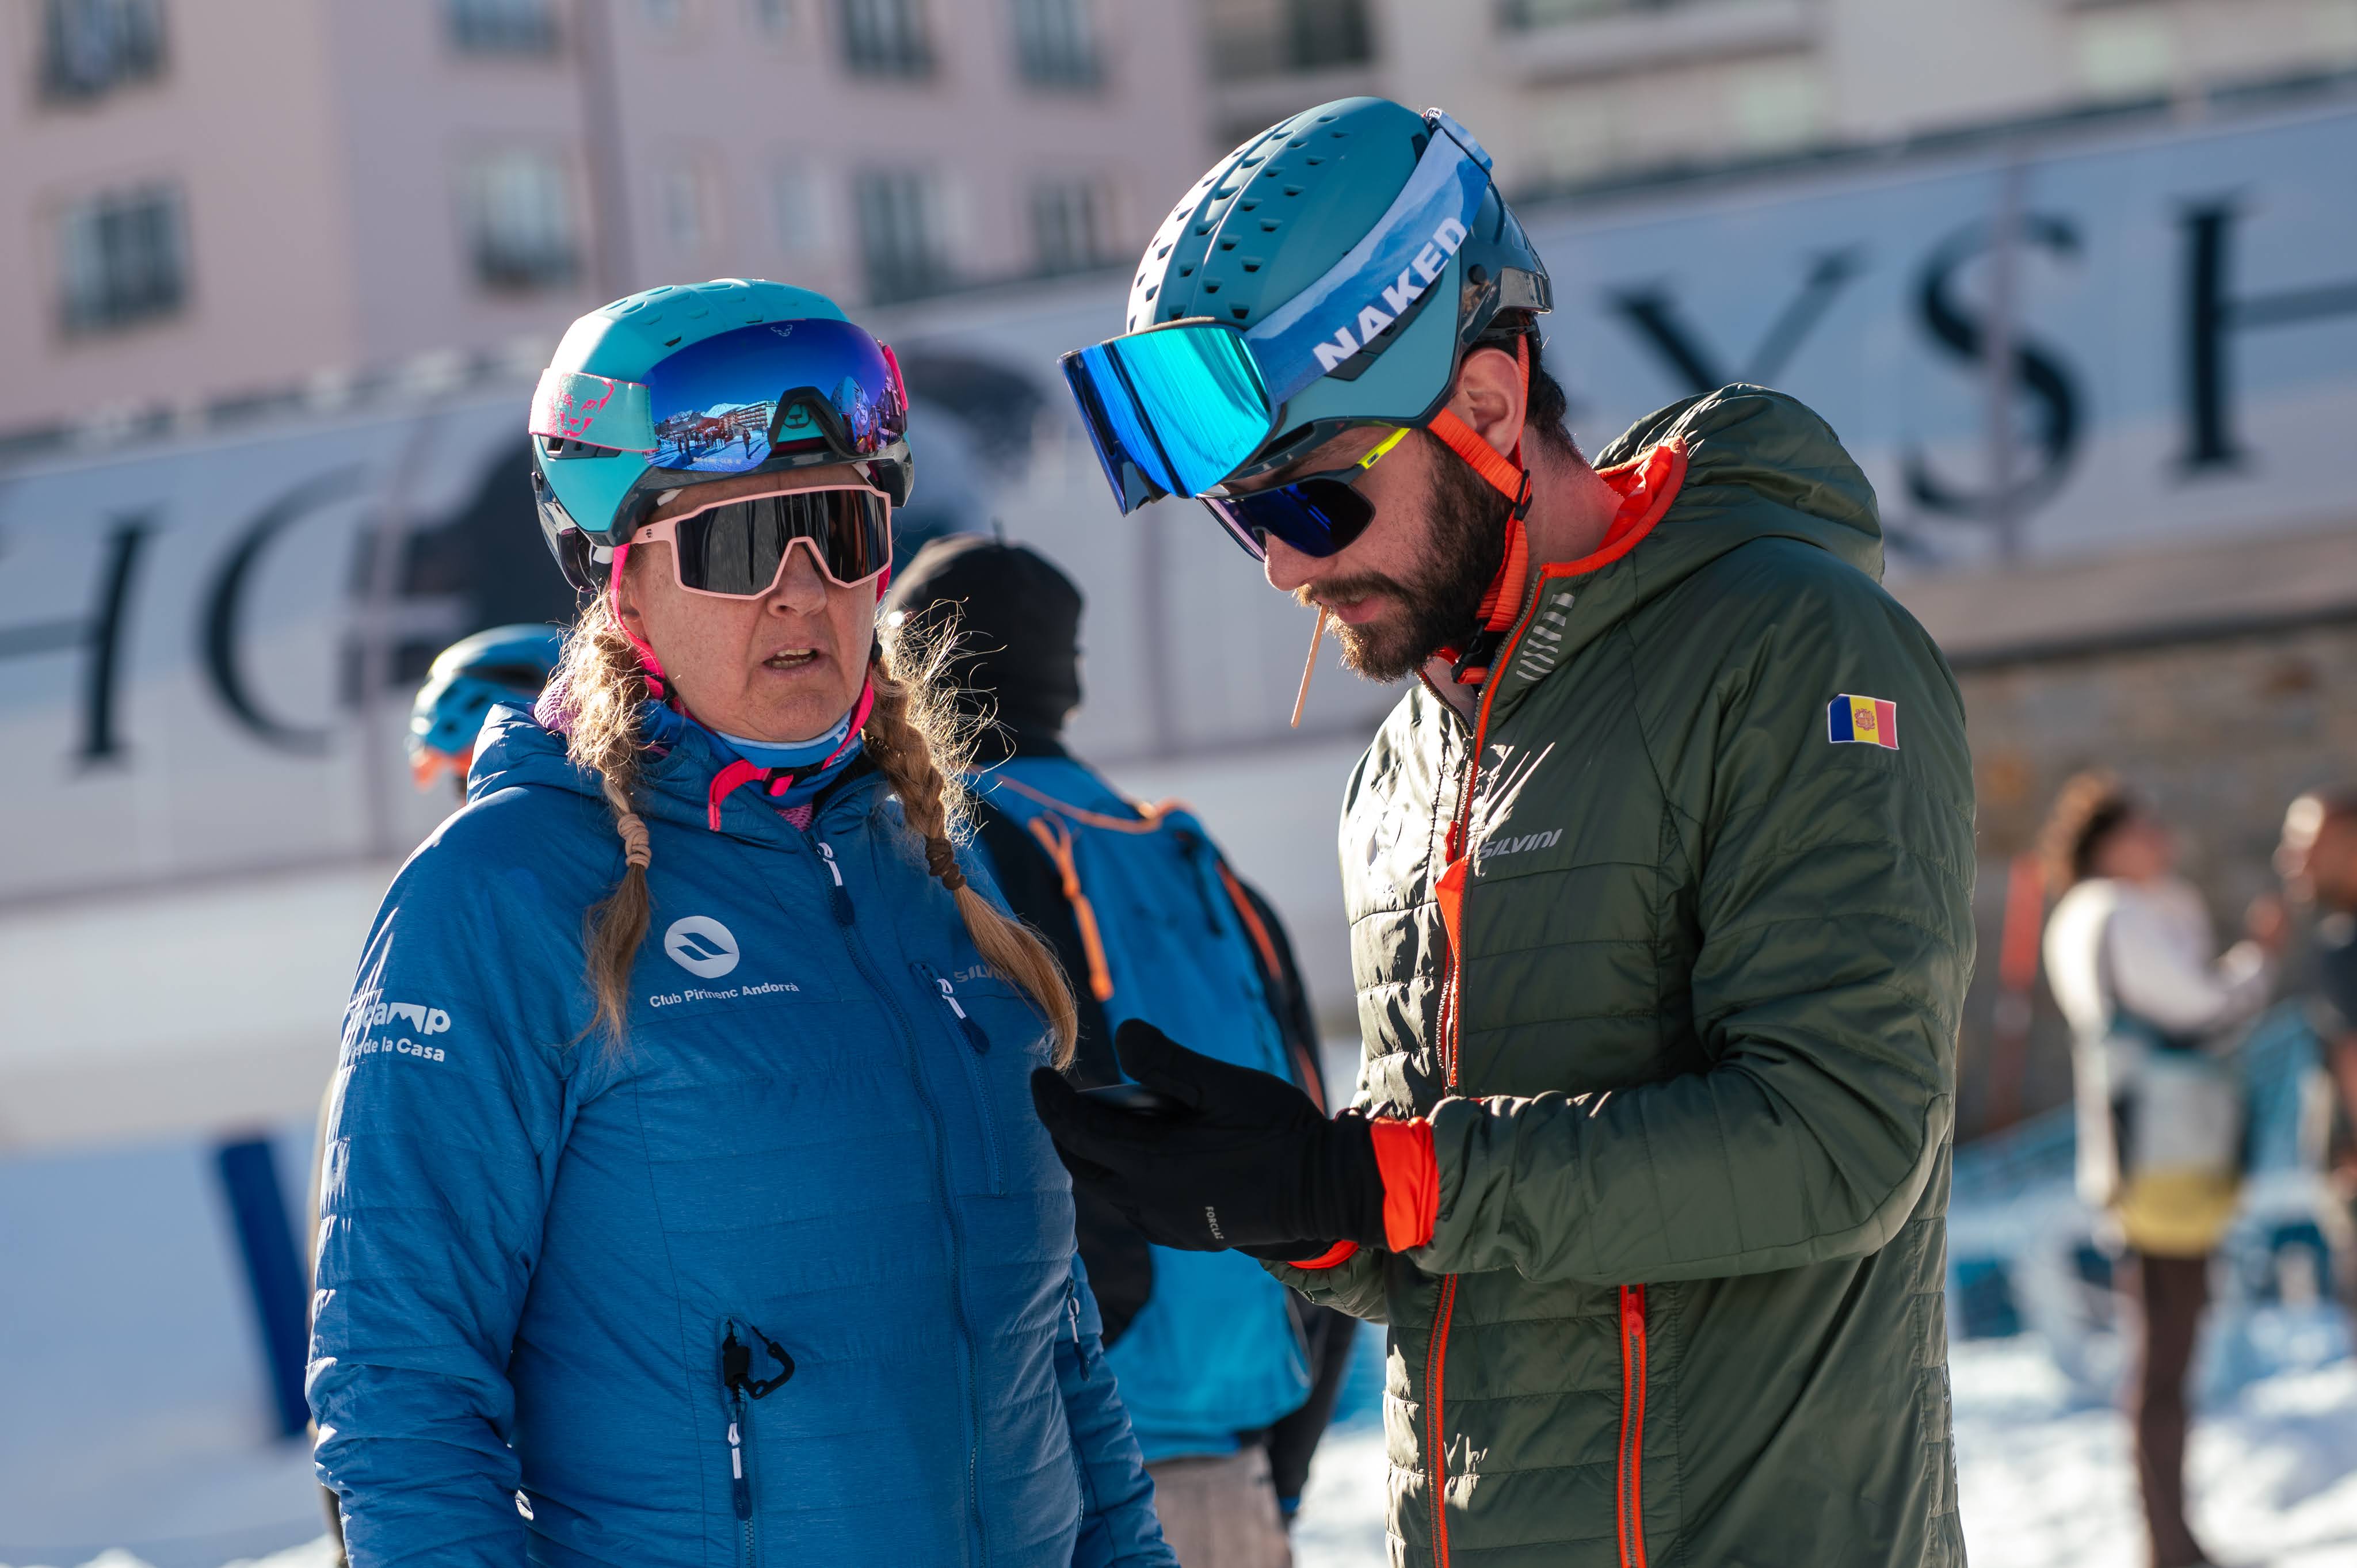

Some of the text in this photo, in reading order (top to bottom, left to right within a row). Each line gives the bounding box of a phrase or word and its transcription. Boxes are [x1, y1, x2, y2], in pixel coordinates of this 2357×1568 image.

[1313, 218, 1467, 372] NAKED
[1478, 828, 1563, 861] SILVINI
[650, 982, 800, 1008] Club Pirinenc Andorrà
[363, 1038, 378, 1054] de
[382, 1036, 393, 1052] la
[396, 1037, 445, 1062] Casa
